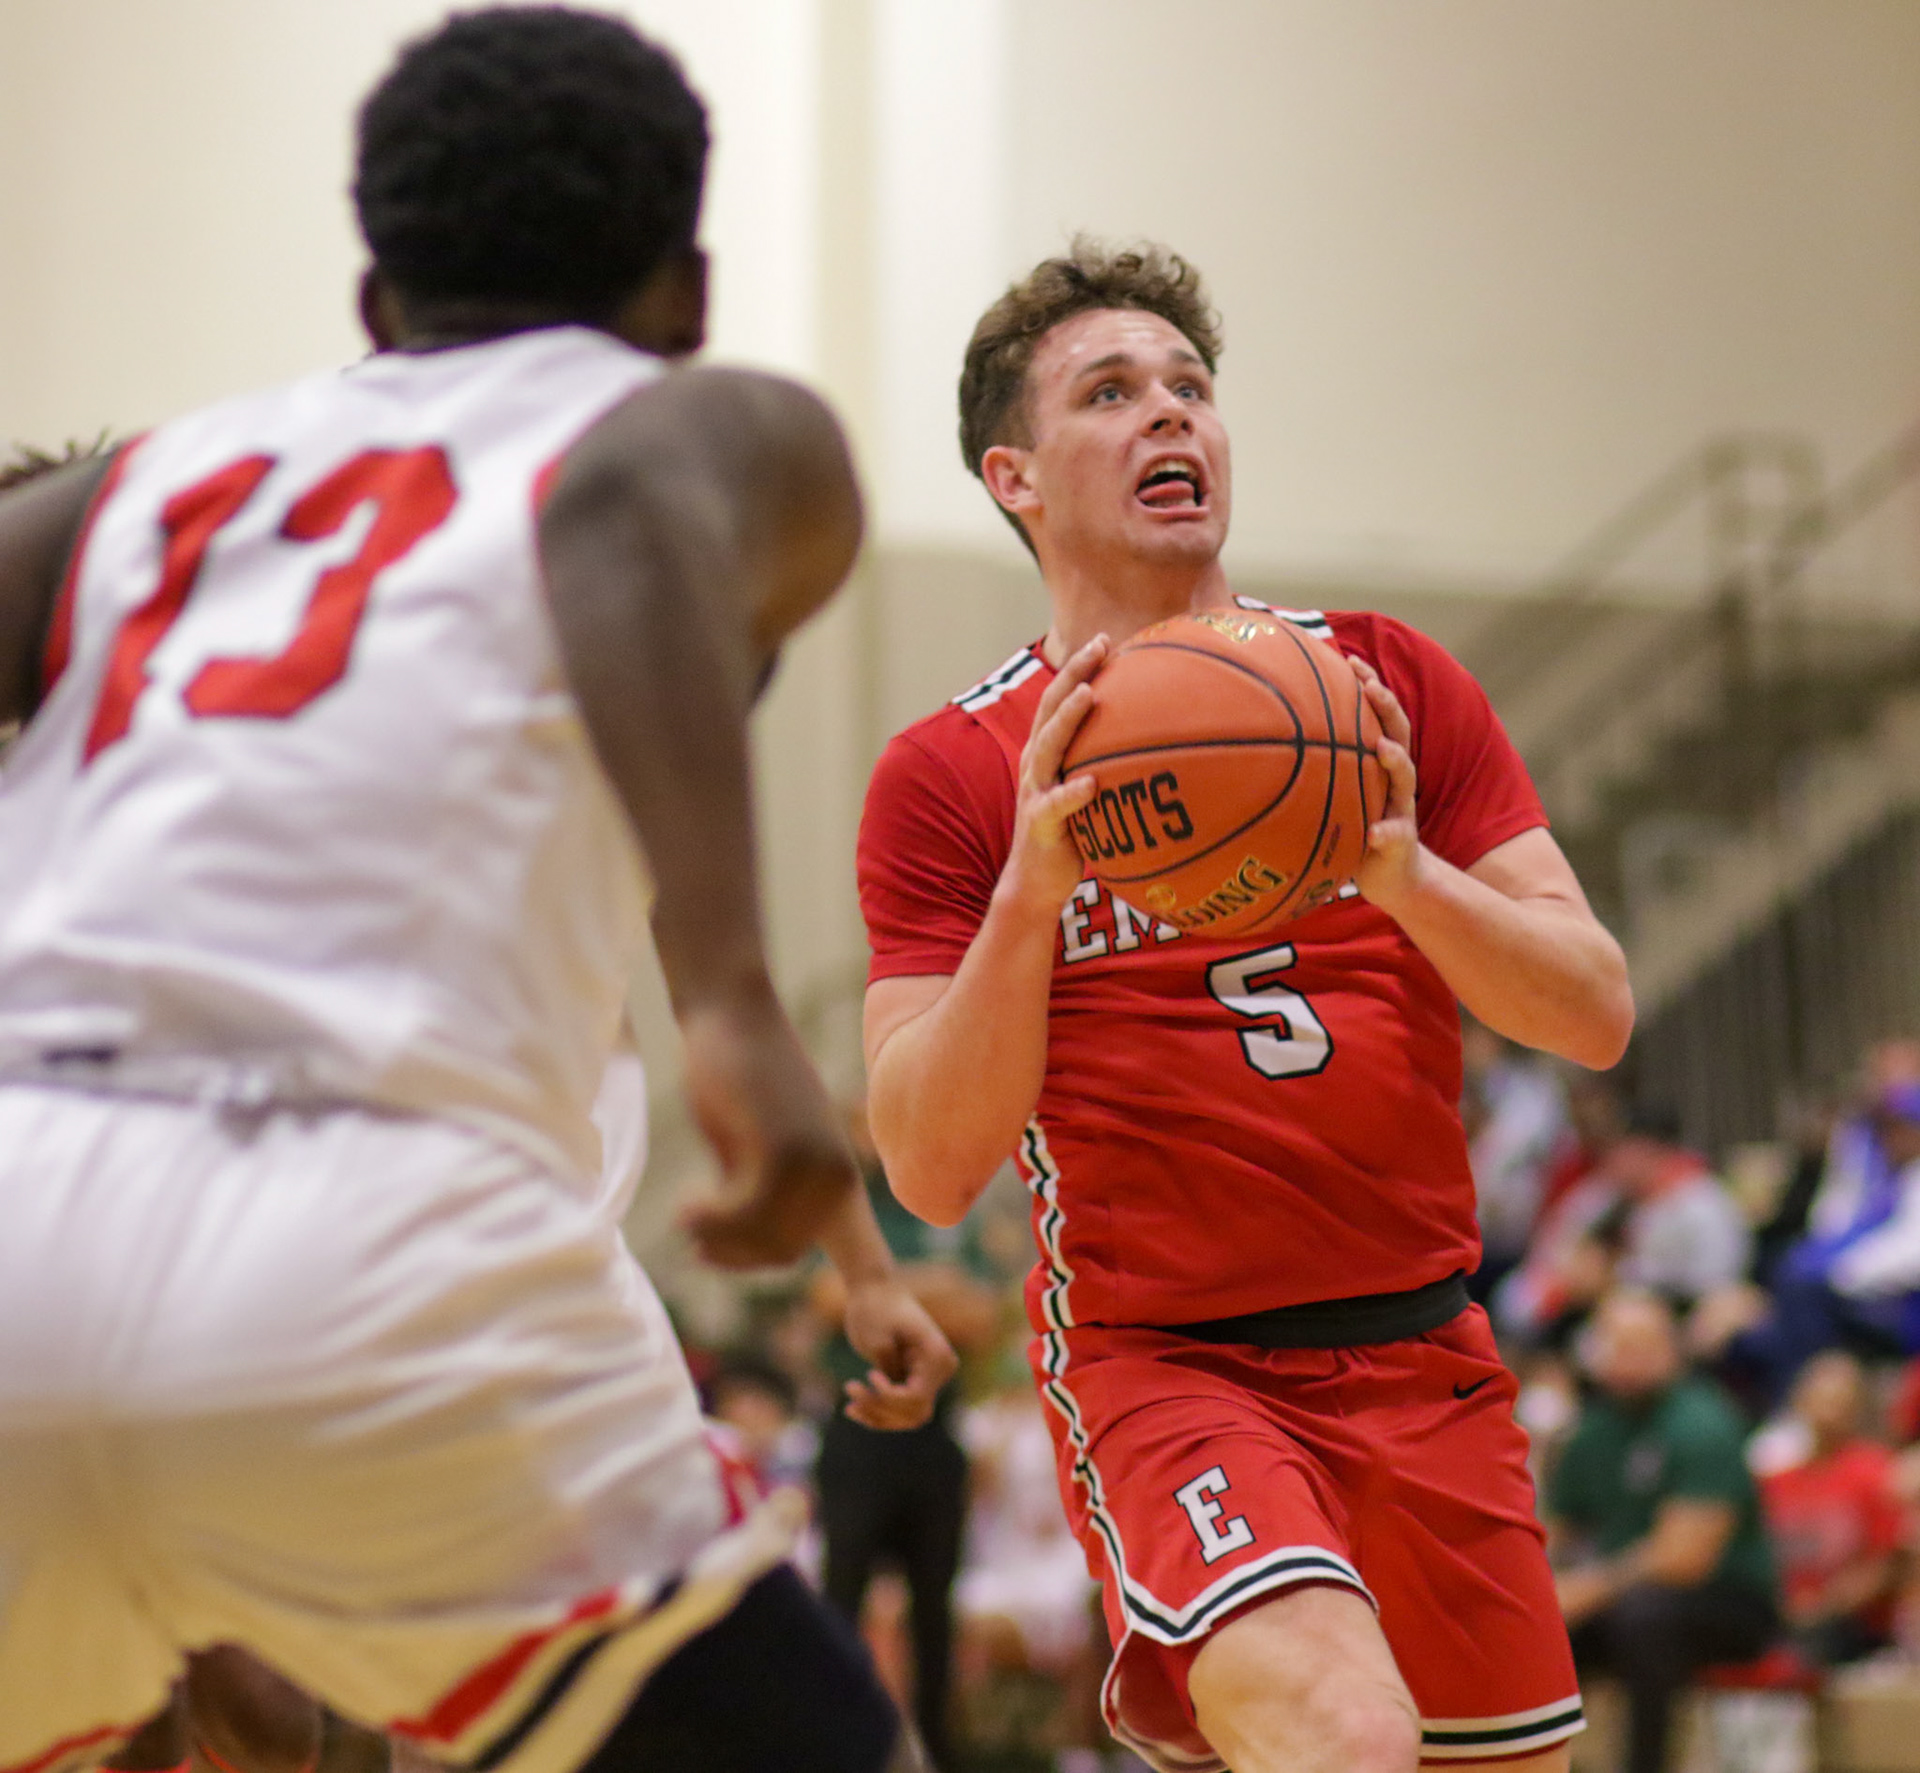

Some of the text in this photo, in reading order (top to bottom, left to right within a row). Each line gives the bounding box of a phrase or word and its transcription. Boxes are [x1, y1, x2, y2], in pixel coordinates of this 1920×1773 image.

[79, 441, 460, 772] 13
[1203, 940, 1334, 1081] 5
[1172, 1464, 1257, 1567] E
